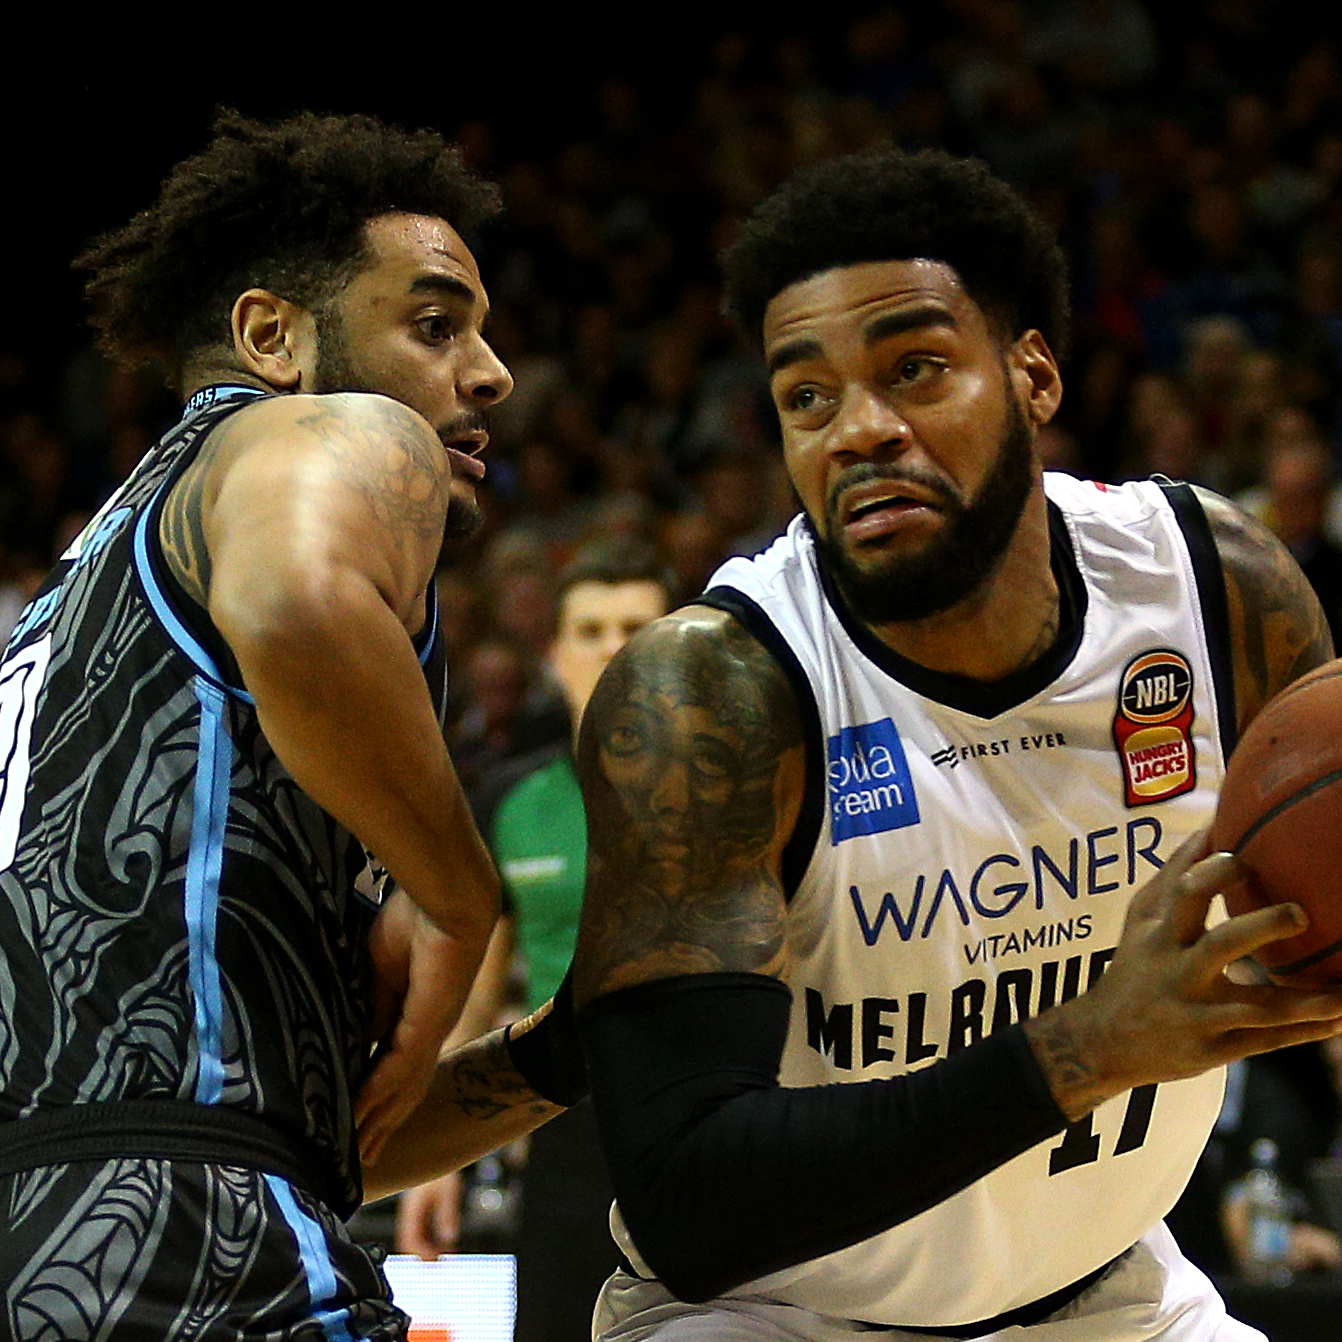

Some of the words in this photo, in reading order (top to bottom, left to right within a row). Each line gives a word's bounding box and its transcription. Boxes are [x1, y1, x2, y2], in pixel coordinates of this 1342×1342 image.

[1135, 672, 1179, 710] NBL
[828, 742, 897, 793] oda
[960, 739, 1011, 761] FIRST
[1020, 731, 1067, 751] EVER
[1129, 740, 1184, 765] HUNGRY
[849, 815, 1165, 947] WAGNER
[963, 913, 1093, 966] VITAMINS
